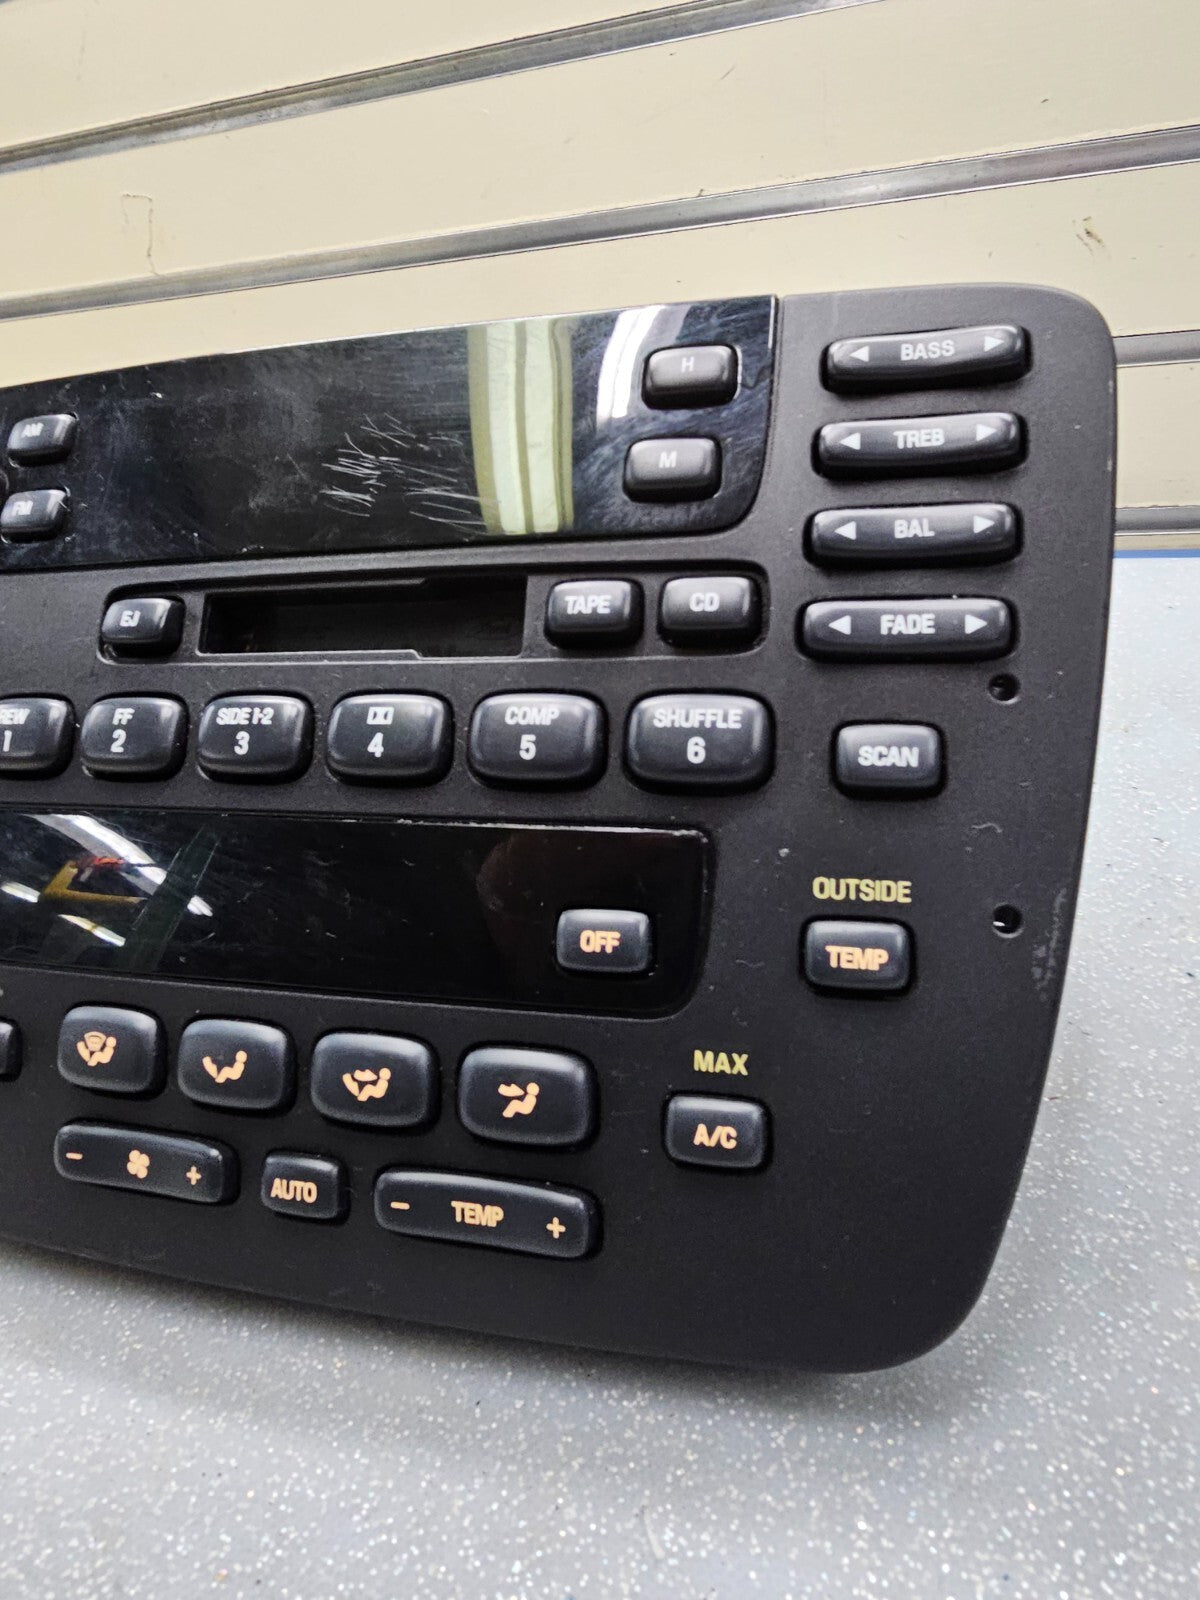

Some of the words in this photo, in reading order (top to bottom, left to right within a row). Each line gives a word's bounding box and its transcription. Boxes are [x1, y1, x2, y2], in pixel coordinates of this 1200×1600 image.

[899, 339, 955, 362] BASS
[681, 356, 695, 374] H
[893, 428, 945, 449] TREB
[659, 450, 677, 469] M
[894, 518, 935, 539] BAL
[565, 594, 611, 615] TAPE
[690, 593, 720, 613] CD
[120, 610, 140, 628] EJ
[880, 613, 936, 636] FADE
[113, 707, 134, 725] FF
[216, 707, 250, 726] SIDE
[505, 707, 560, 726] COMP
[653, 708, 742, 730] SHUFFLE
[2, 729, 11, 752] 1
[111, 728, 125, 753] 2
[234, 730, 250, 755] 3
[367, 732, 384, 758] 4
[519, 734, 537, 761] 5
[686, 737, 706, 764] 6
[858, 745, 920, 768] SCAN
[812, 876, 912, 904] OUTSIDE
[579, 930, 621, 954] OFF
[825, 944, 889, 972] TEMP
[693, 1049, 749, 1076] MAX
[693, 1124, 737, 1150] A/C
[270, 1177, 318, 1204] AUTO
[451, 1200, 504, 1228] TEMP
